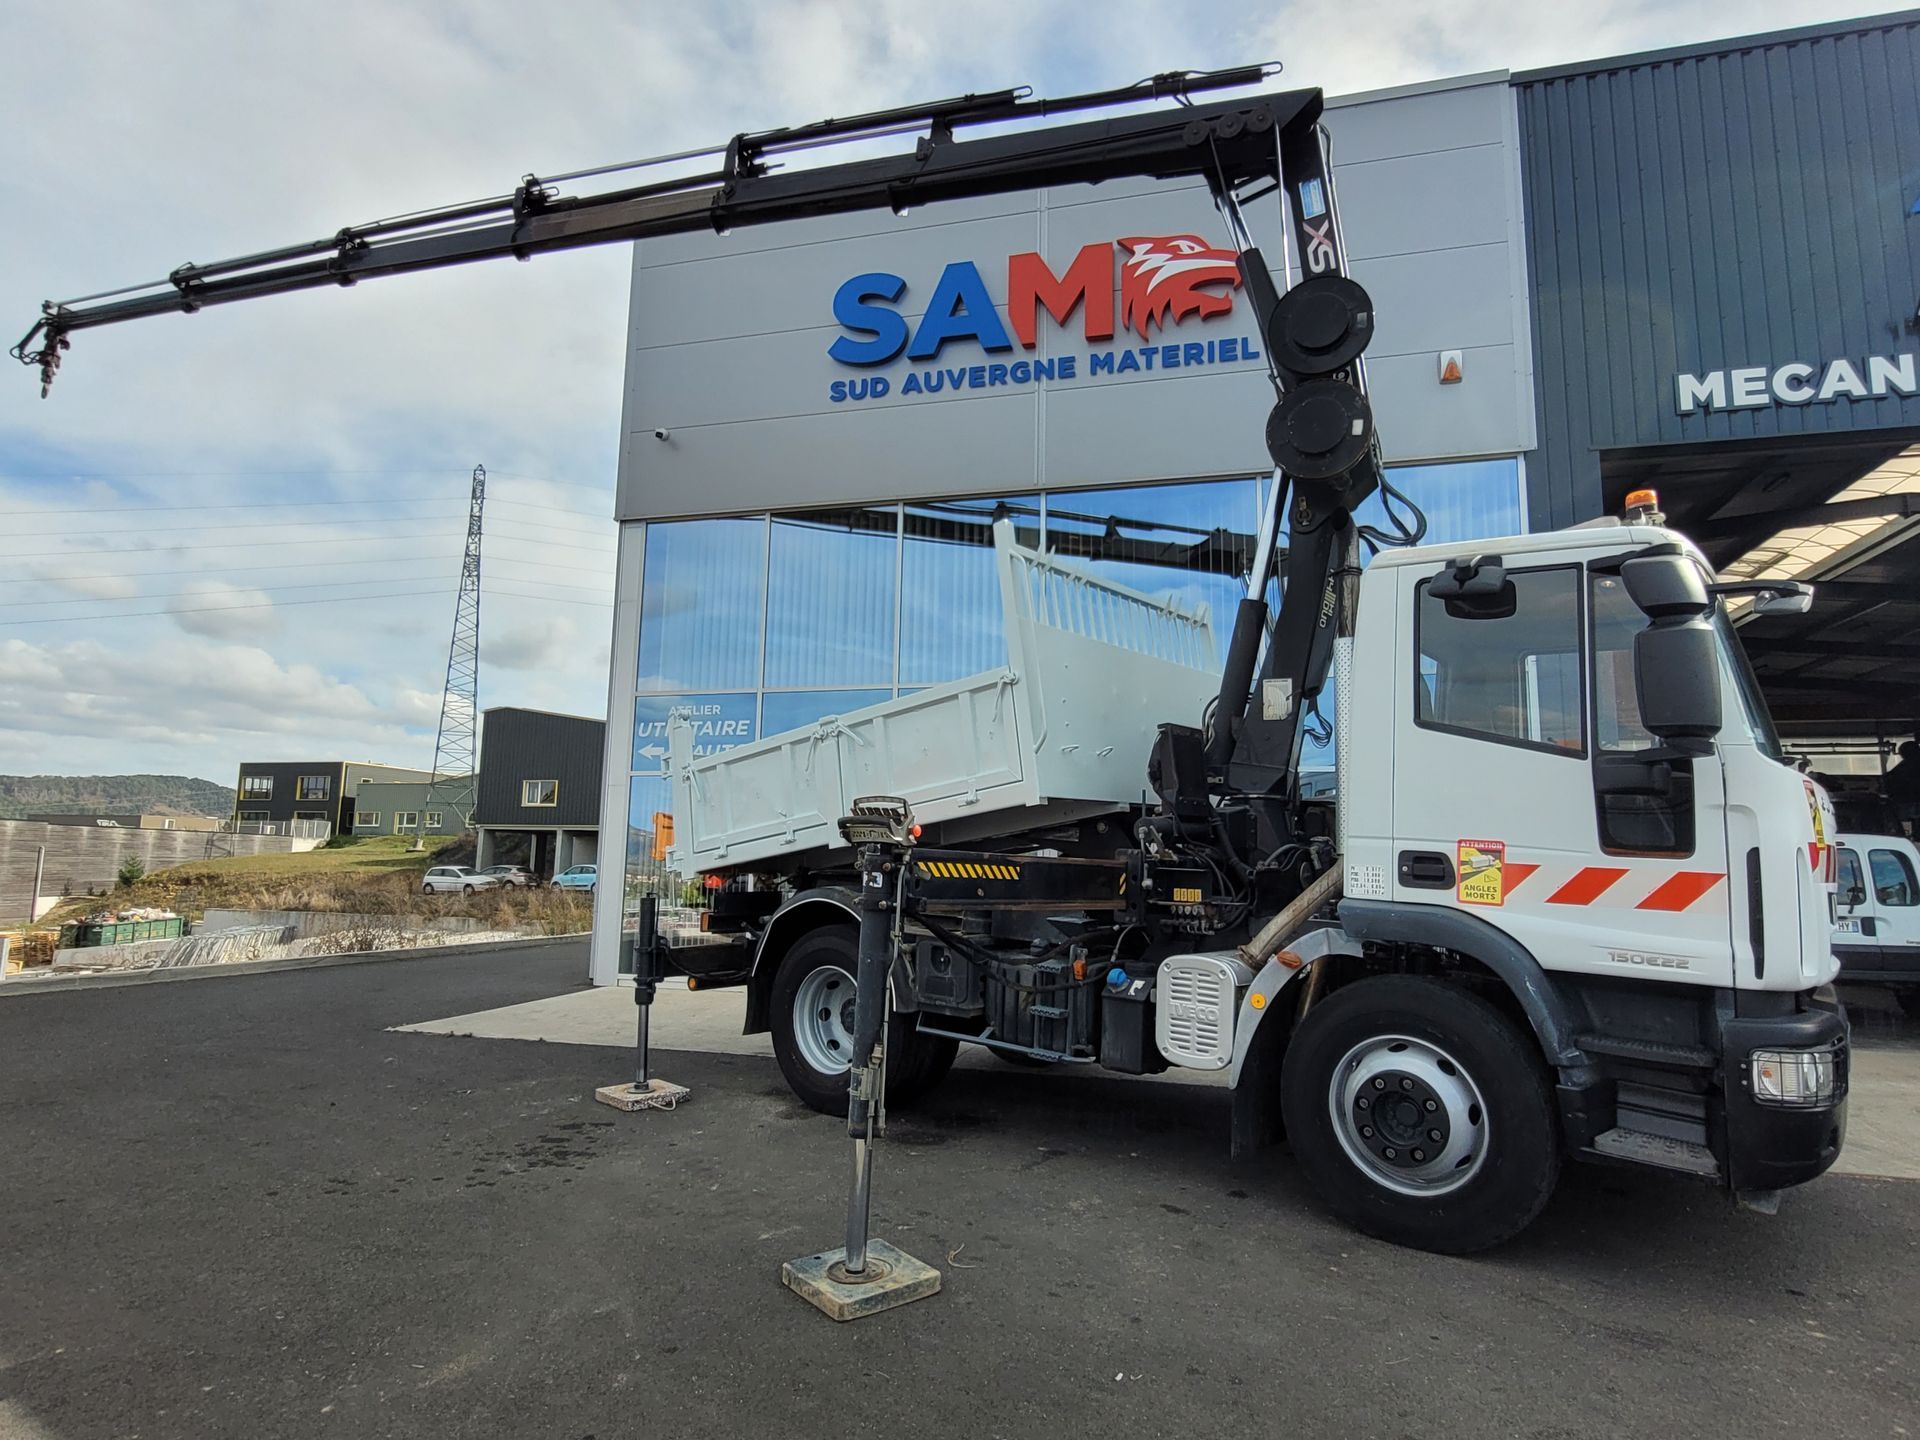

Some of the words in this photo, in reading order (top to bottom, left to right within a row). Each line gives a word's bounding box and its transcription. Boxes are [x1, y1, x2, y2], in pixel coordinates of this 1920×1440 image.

[828, 242, 1114, 368] SAM
[829, 376, 890, 402] SUD
[901, 356, 1076, 395] AUVERGNE
[1090, 336, 1260, 375] MATERIEL
[1677, 353, 1918, 412] MECAN
[1460, 841, 1503, 849] ATTENTION
[1464, 884, 1498, 893] ANGLES
[1465, 891, 1496, 900] MORTS
[1607, 951, 1690, 970] 150E22
